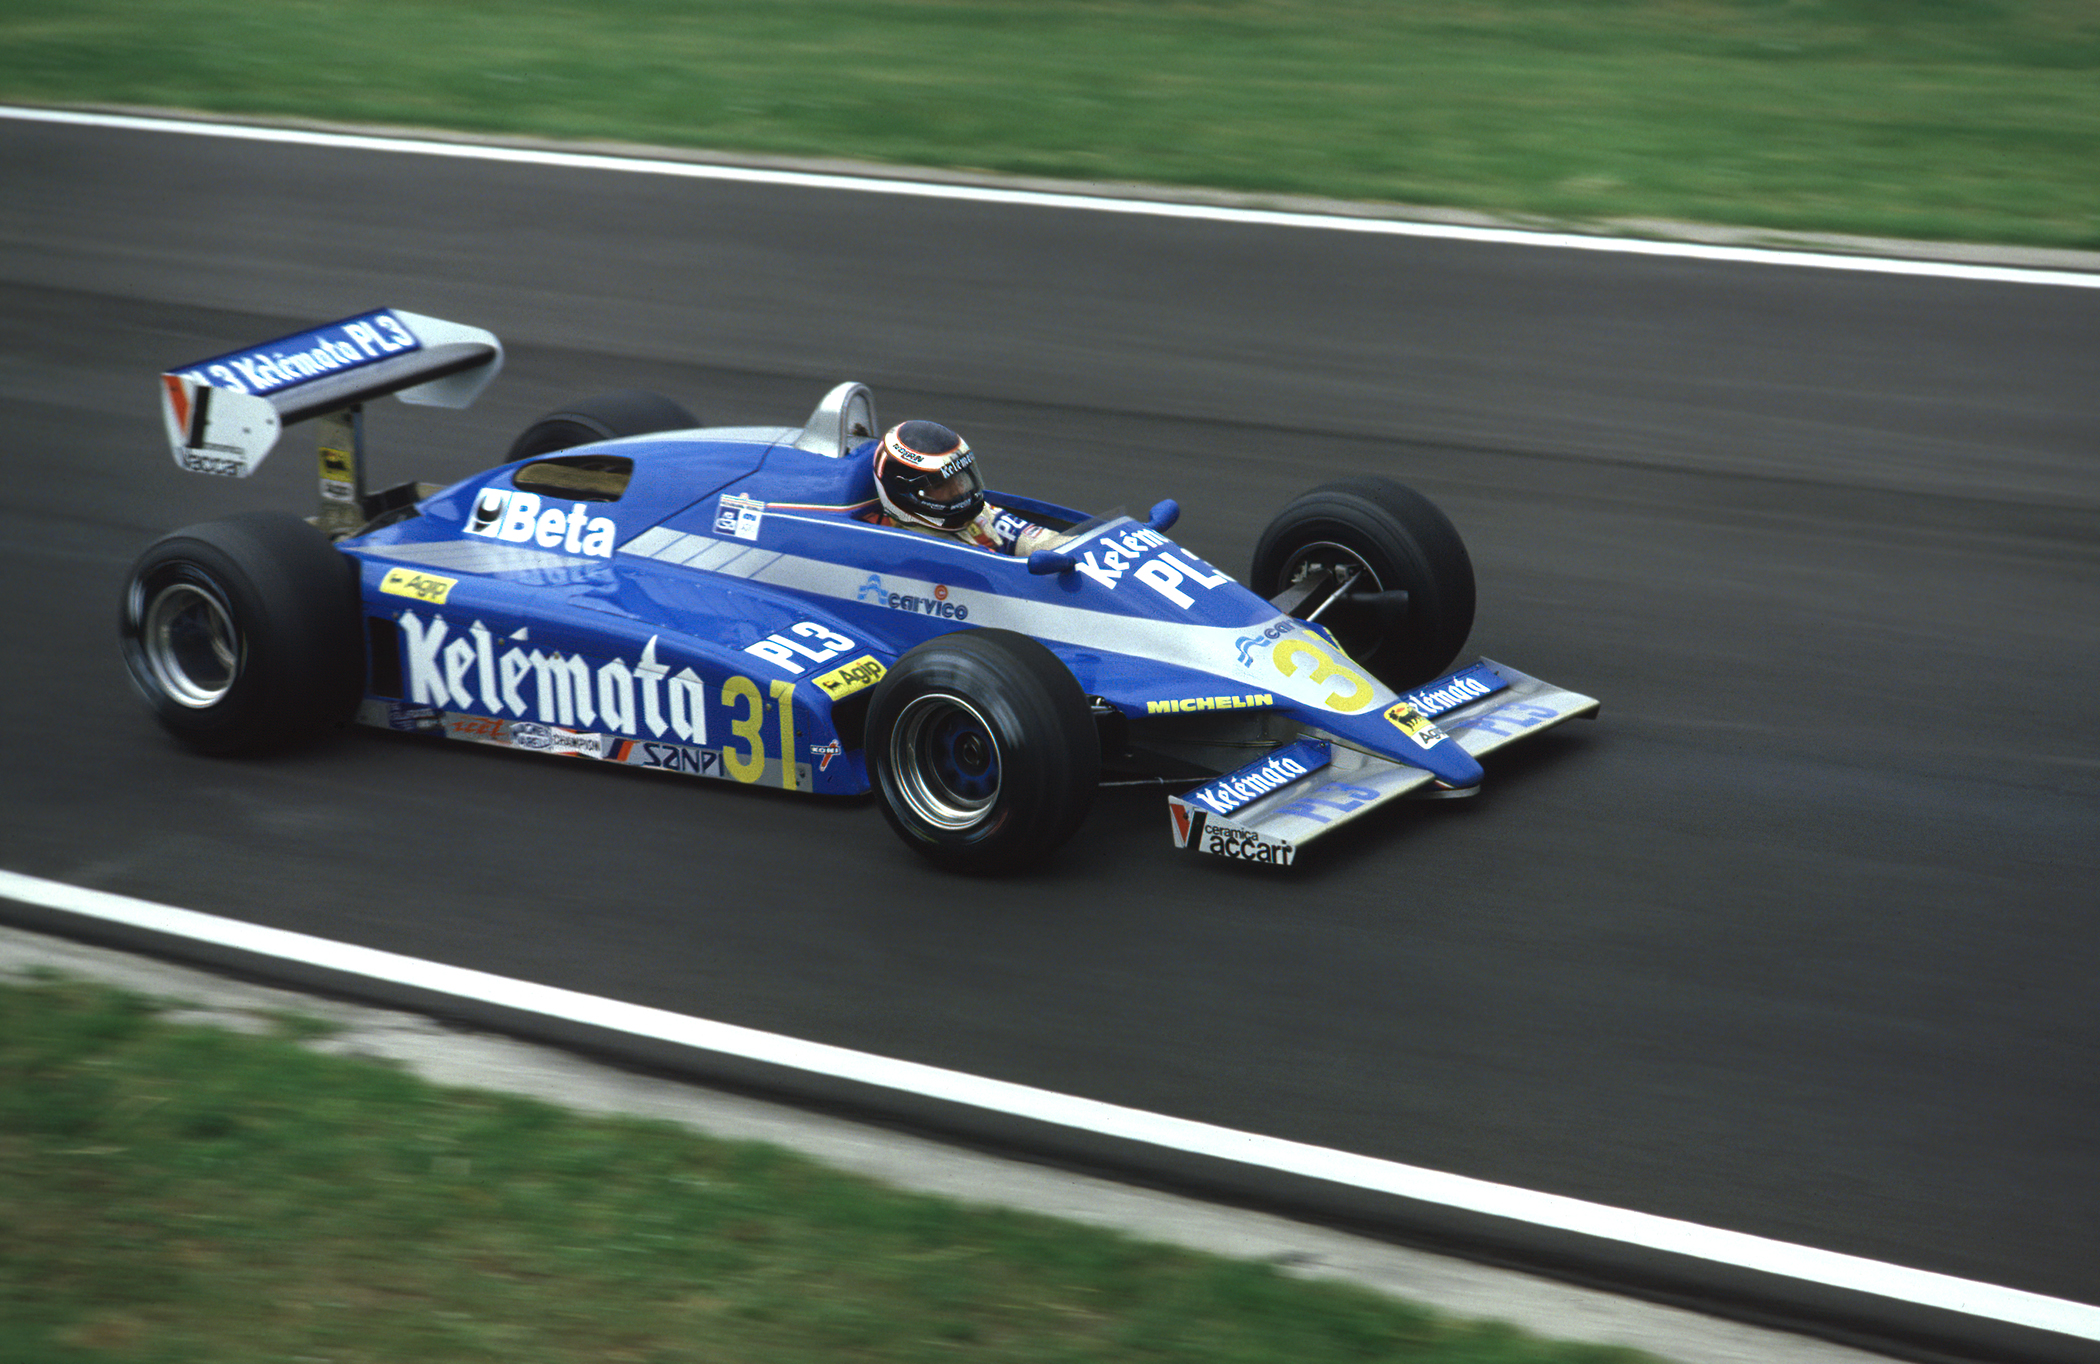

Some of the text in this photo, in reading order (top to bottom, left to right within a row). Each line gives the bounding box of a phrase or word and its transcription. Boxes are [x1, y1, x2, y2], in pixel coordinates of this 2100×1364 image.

[341, 315, 416, 357] PL3
[498, 491, 616, 558] Beta
[1075, 528, 1172, 590] Kelém
[404, 575, 448, 601] Agip
[888, 584, 968, 621] carvico
[744, 621, 856, 674] PL3
[399, 609, 707, 746] Kelémata
[840, 659, 882, 685] Agip
[1273, 627, 1374, 713] 3
[1146, 693, 1274, 714] MICHELIN
[721, 675, 797, 791] 31
[1418, 726, 1448, 745] Ag
[1196, 756, 1308, 814] Kelémata
[1273, 782, 1382, 825] PL3
[1205, 824, 1259, 842] ceramica
